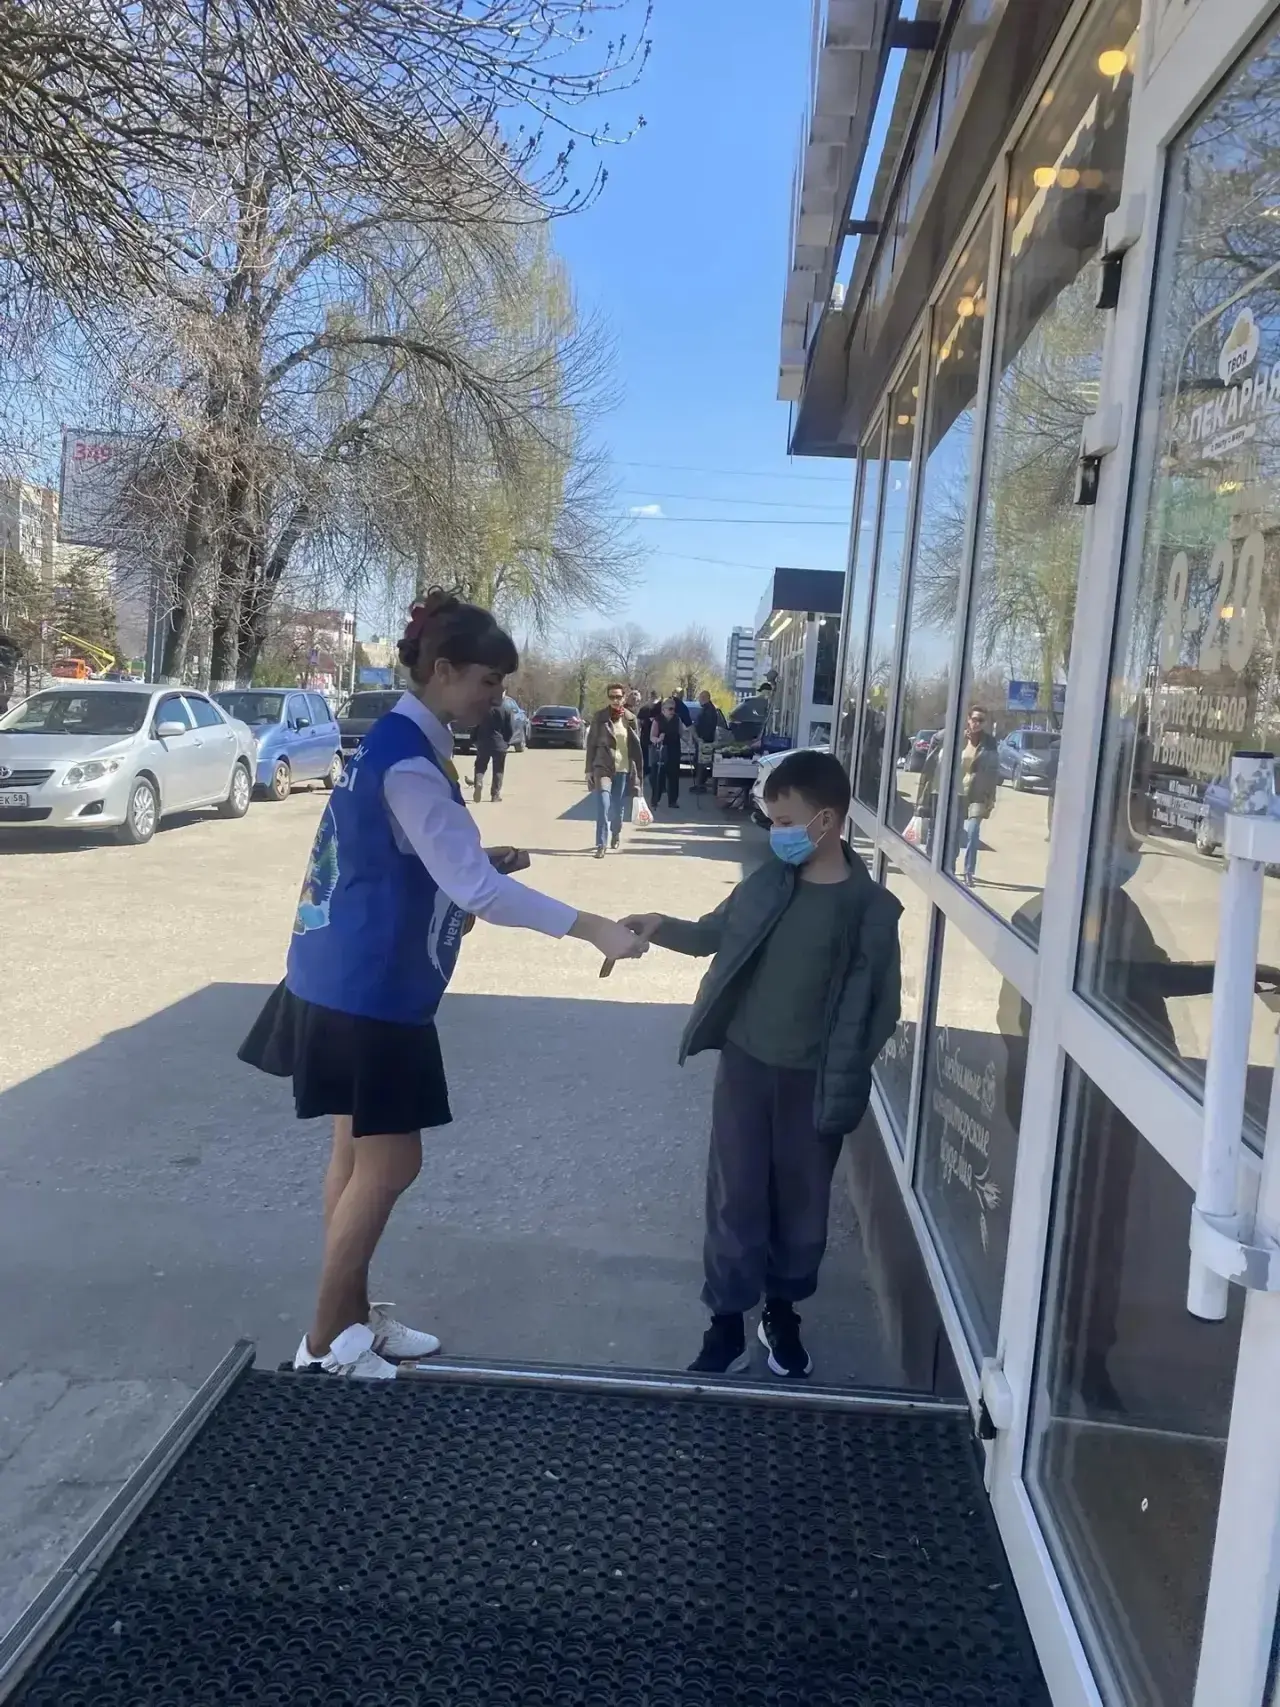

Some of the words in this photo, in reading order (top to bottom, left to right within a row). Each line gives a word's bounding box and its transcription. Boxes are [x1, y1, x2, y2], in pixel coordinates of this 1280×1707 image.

[1227, 350, 1248, 374] ТВОЯ
[1189, 361, 1280, 443] ПЕКАРНЯ
[1159, 530, 1265, 672] 8-20
[1170, 694, 1247, 733] ПЕРЕРЫВОВ
